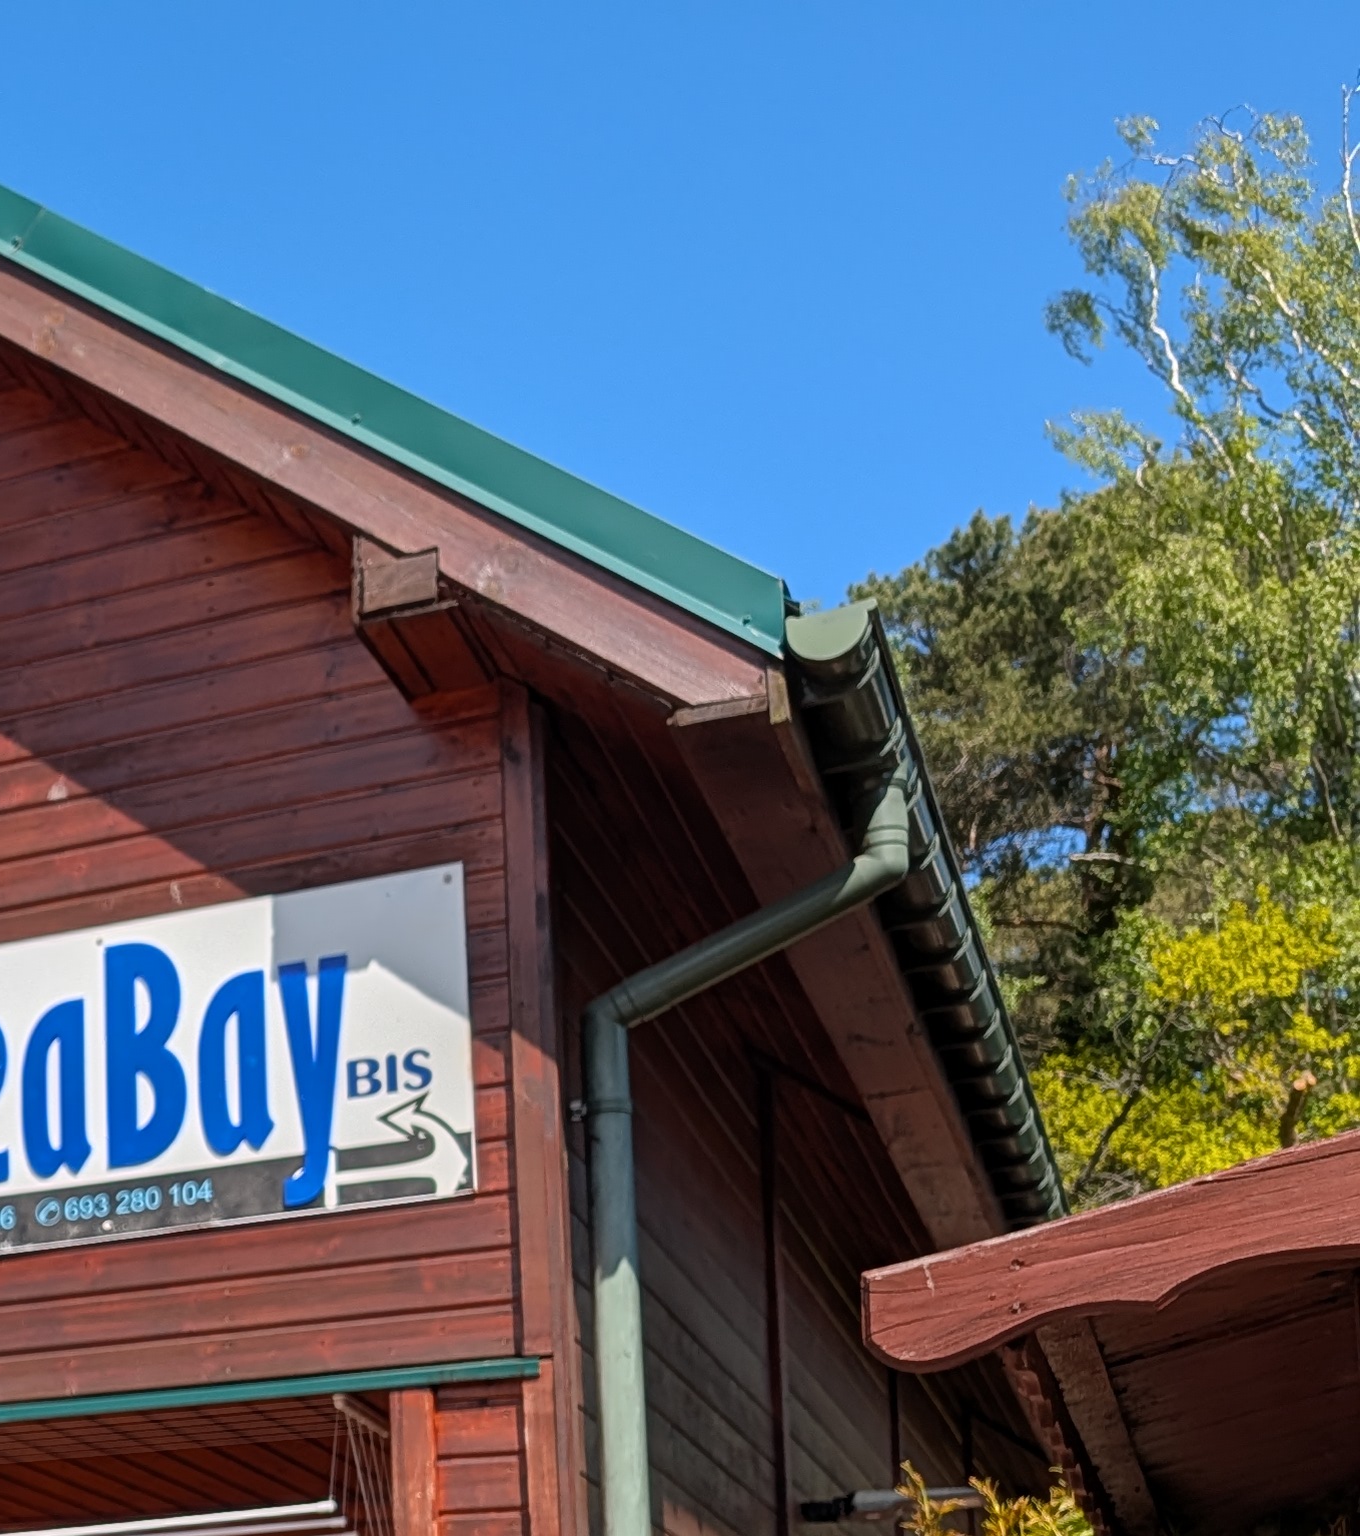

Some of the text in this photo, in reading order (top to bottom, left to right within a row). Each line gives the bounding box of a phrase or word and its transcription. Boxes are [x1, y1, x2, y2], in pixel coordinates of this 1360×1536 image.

[346, 1049, 432, 1100] BIS
[64, 1192, 110, 1221] 693
[115, 1186, 162, 1215] 280
[169, 1178, 213, 1206] 104
